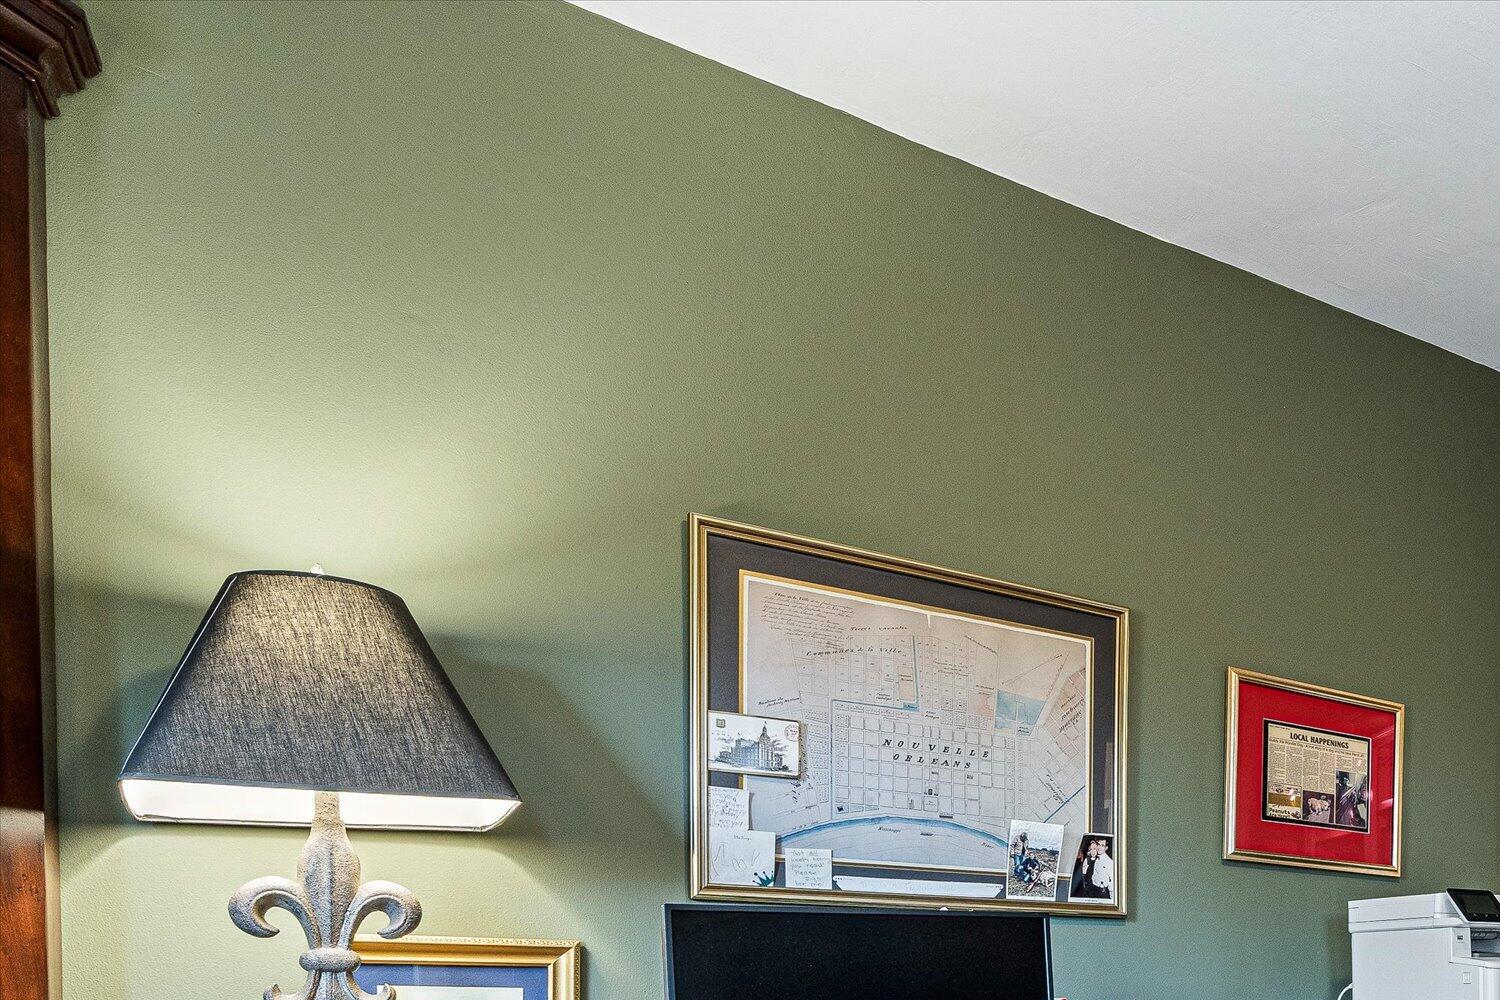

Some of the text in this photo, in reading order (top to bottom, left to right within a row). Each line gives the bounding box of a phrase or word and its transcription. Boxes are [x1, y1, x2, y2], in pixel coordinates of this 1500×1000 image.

[883, 739, 989, 758] NOUVELLE
[1290, 733, 1349, 749] LOCAL HAPPENINGS
